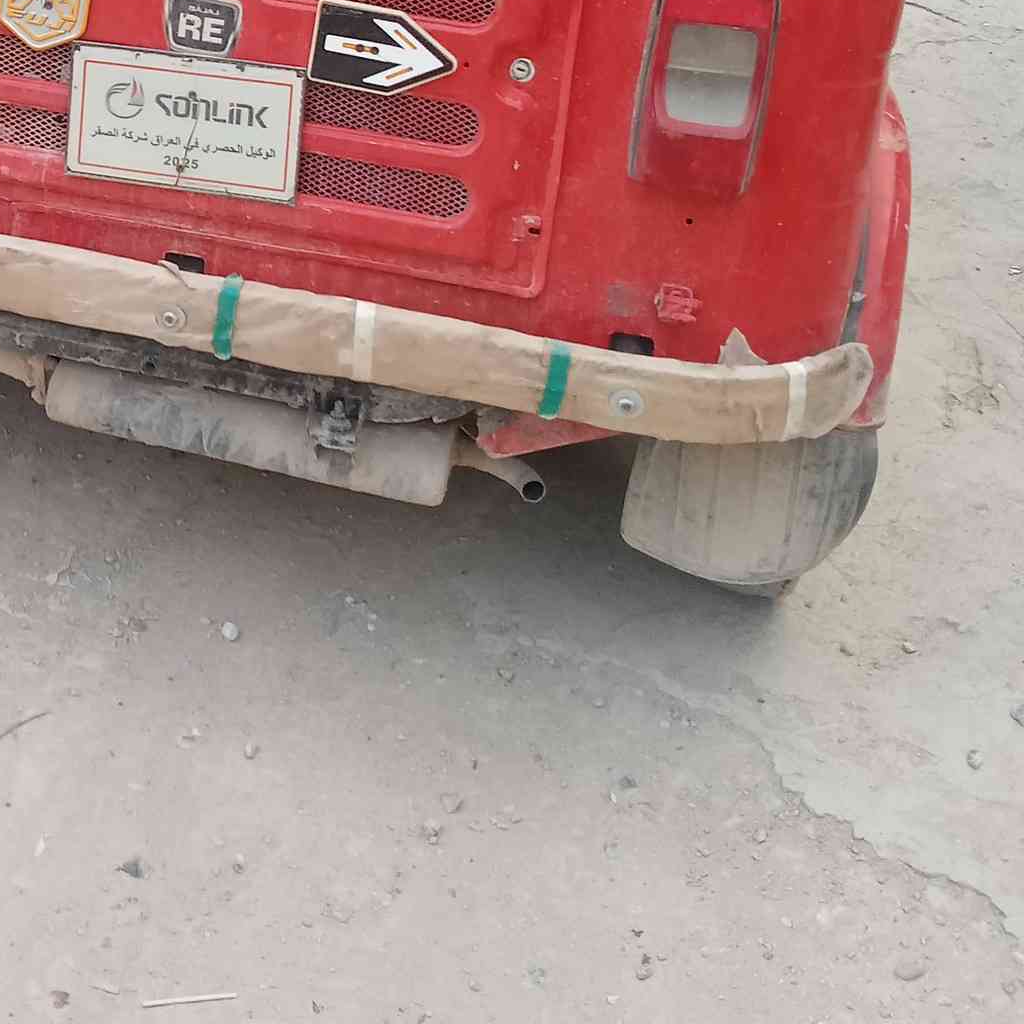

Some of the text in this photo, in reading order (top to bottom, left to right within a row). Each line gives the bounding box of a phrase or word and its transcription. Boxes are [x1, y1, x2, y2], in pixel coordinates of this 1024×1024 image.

[176, 12, 225, 44] RE
[121, 127, 148, 143] شركة
[150, 134, 181, 147] العراق
[183, 137, 199, 151] في
[202, 144, 243, 155] الحصري
[246, 146, 277, 159] الوكيل
[163, 155, 199, 169] 2025
